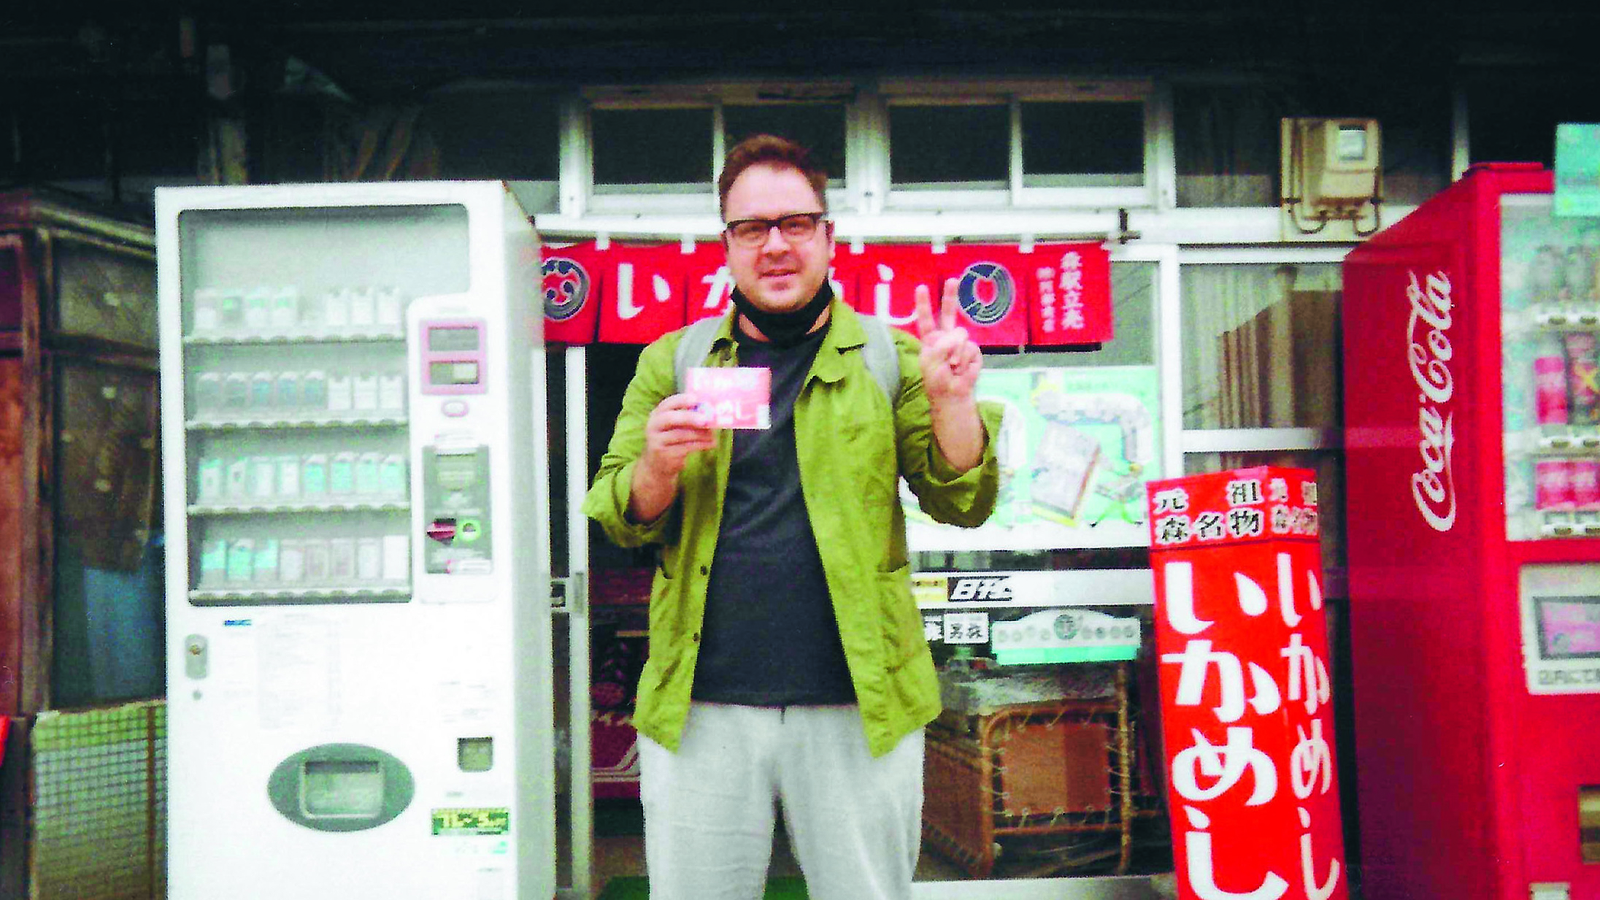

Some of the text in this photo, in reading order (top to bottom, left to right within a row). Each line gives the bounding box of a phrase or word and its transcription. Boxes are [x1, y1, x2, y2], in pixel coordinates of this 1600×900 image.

[1160, 560, 1290, 900] いかめし
[1277, 551, 1340, 900] いかめし
